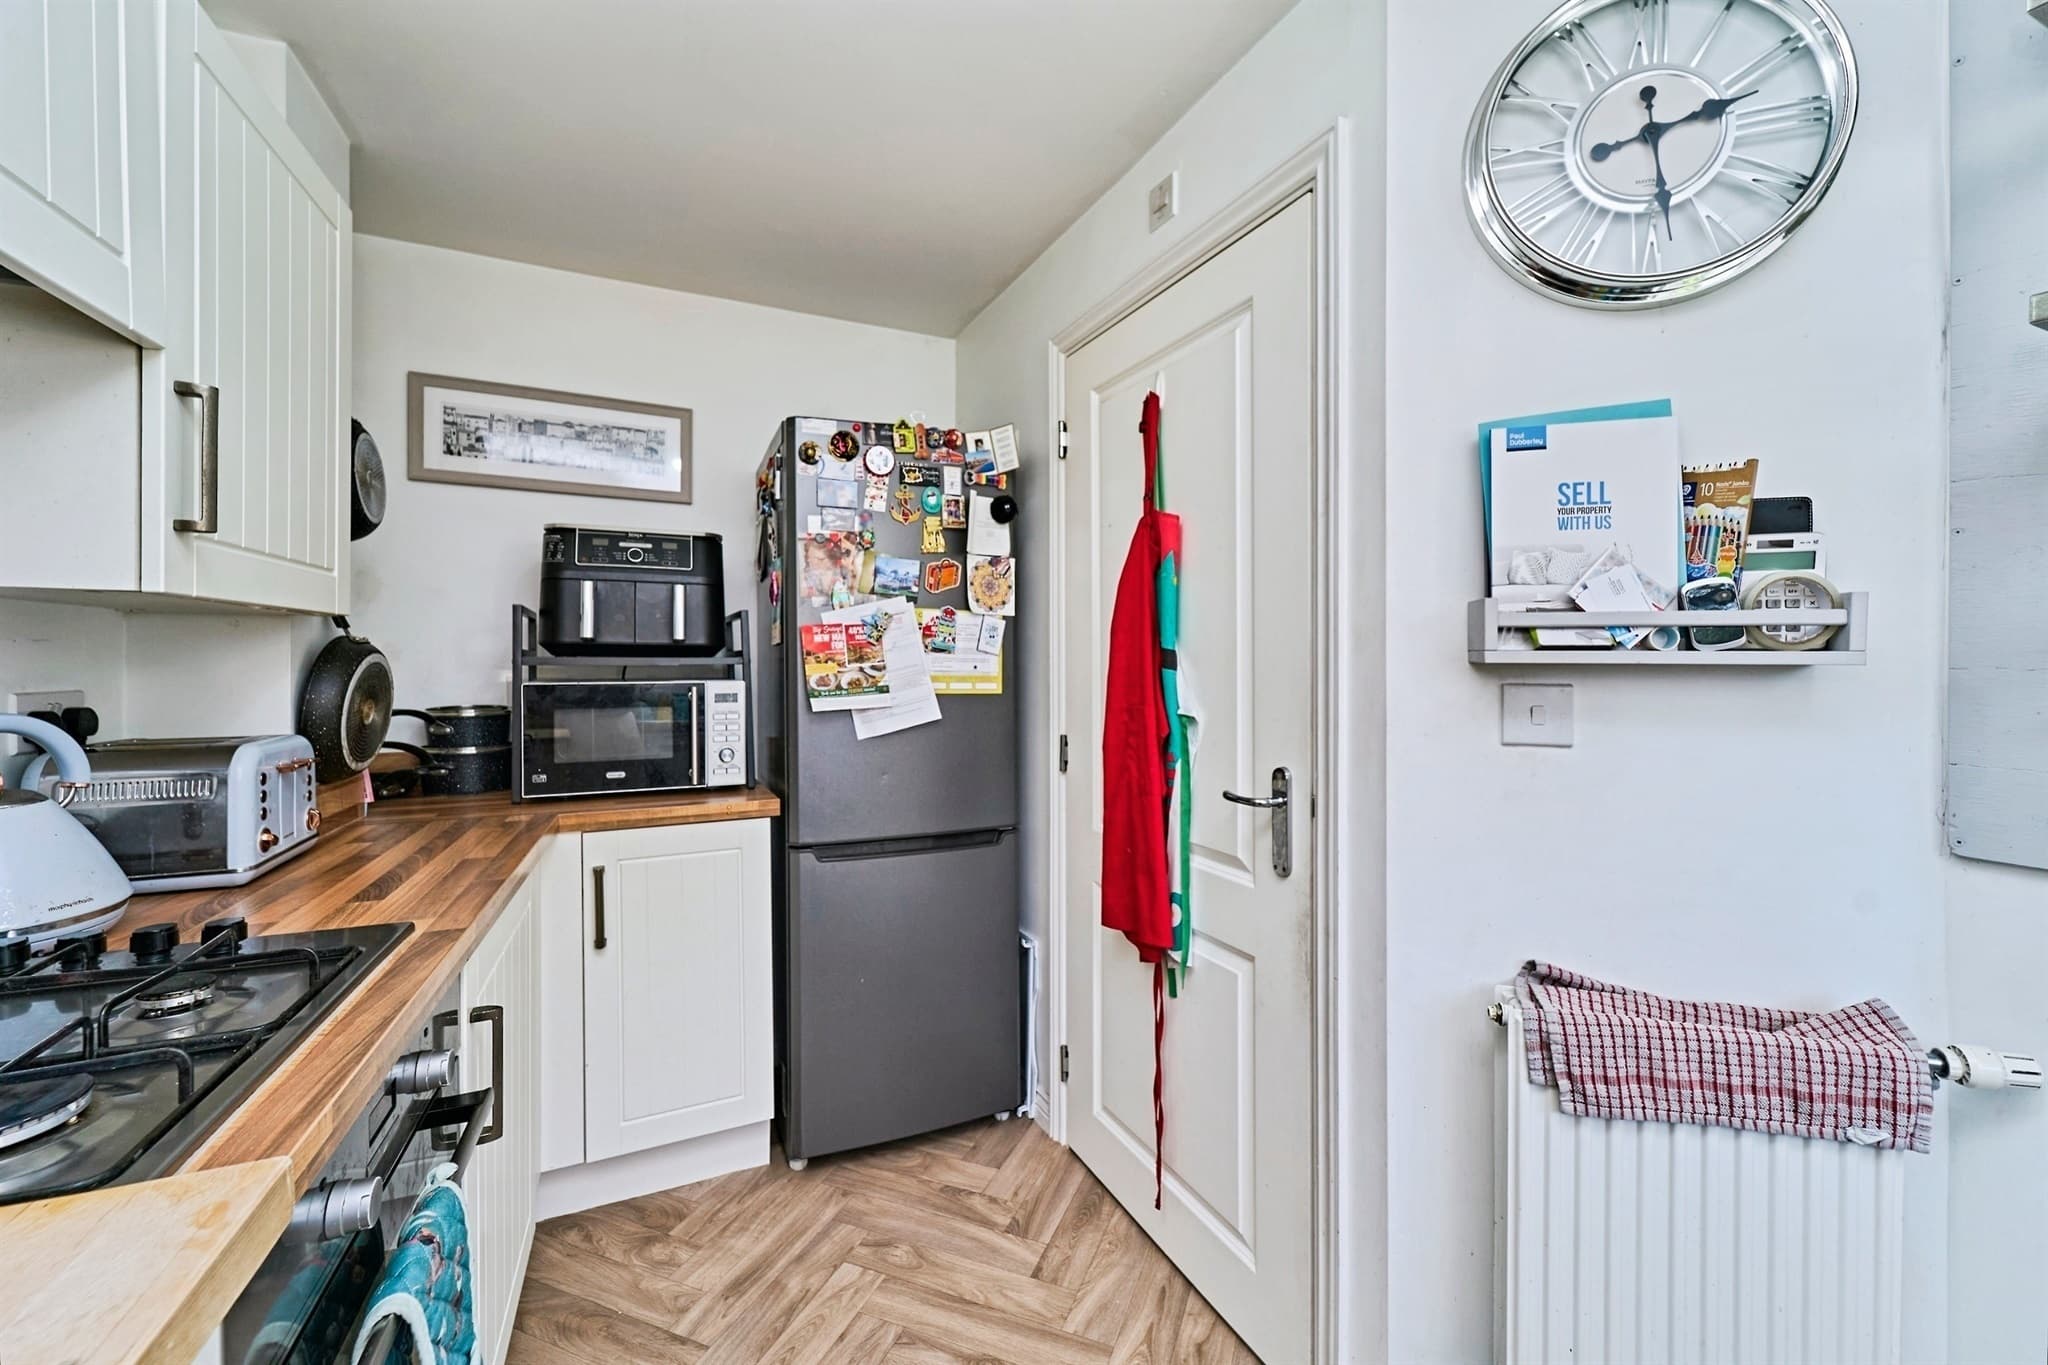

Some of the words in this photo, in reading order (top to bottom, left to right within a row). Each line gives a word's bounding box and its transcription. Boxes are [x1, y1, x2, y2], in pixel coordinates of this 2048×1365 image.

[1557, 481, 1612, 507] SELL
[1700, 482, 1714, 497] 10
[1576, 506, 1612, 515] PROPERTY
[1557, 516, 1590, 531] WITH
[1595, 515, 1612, 529] US
